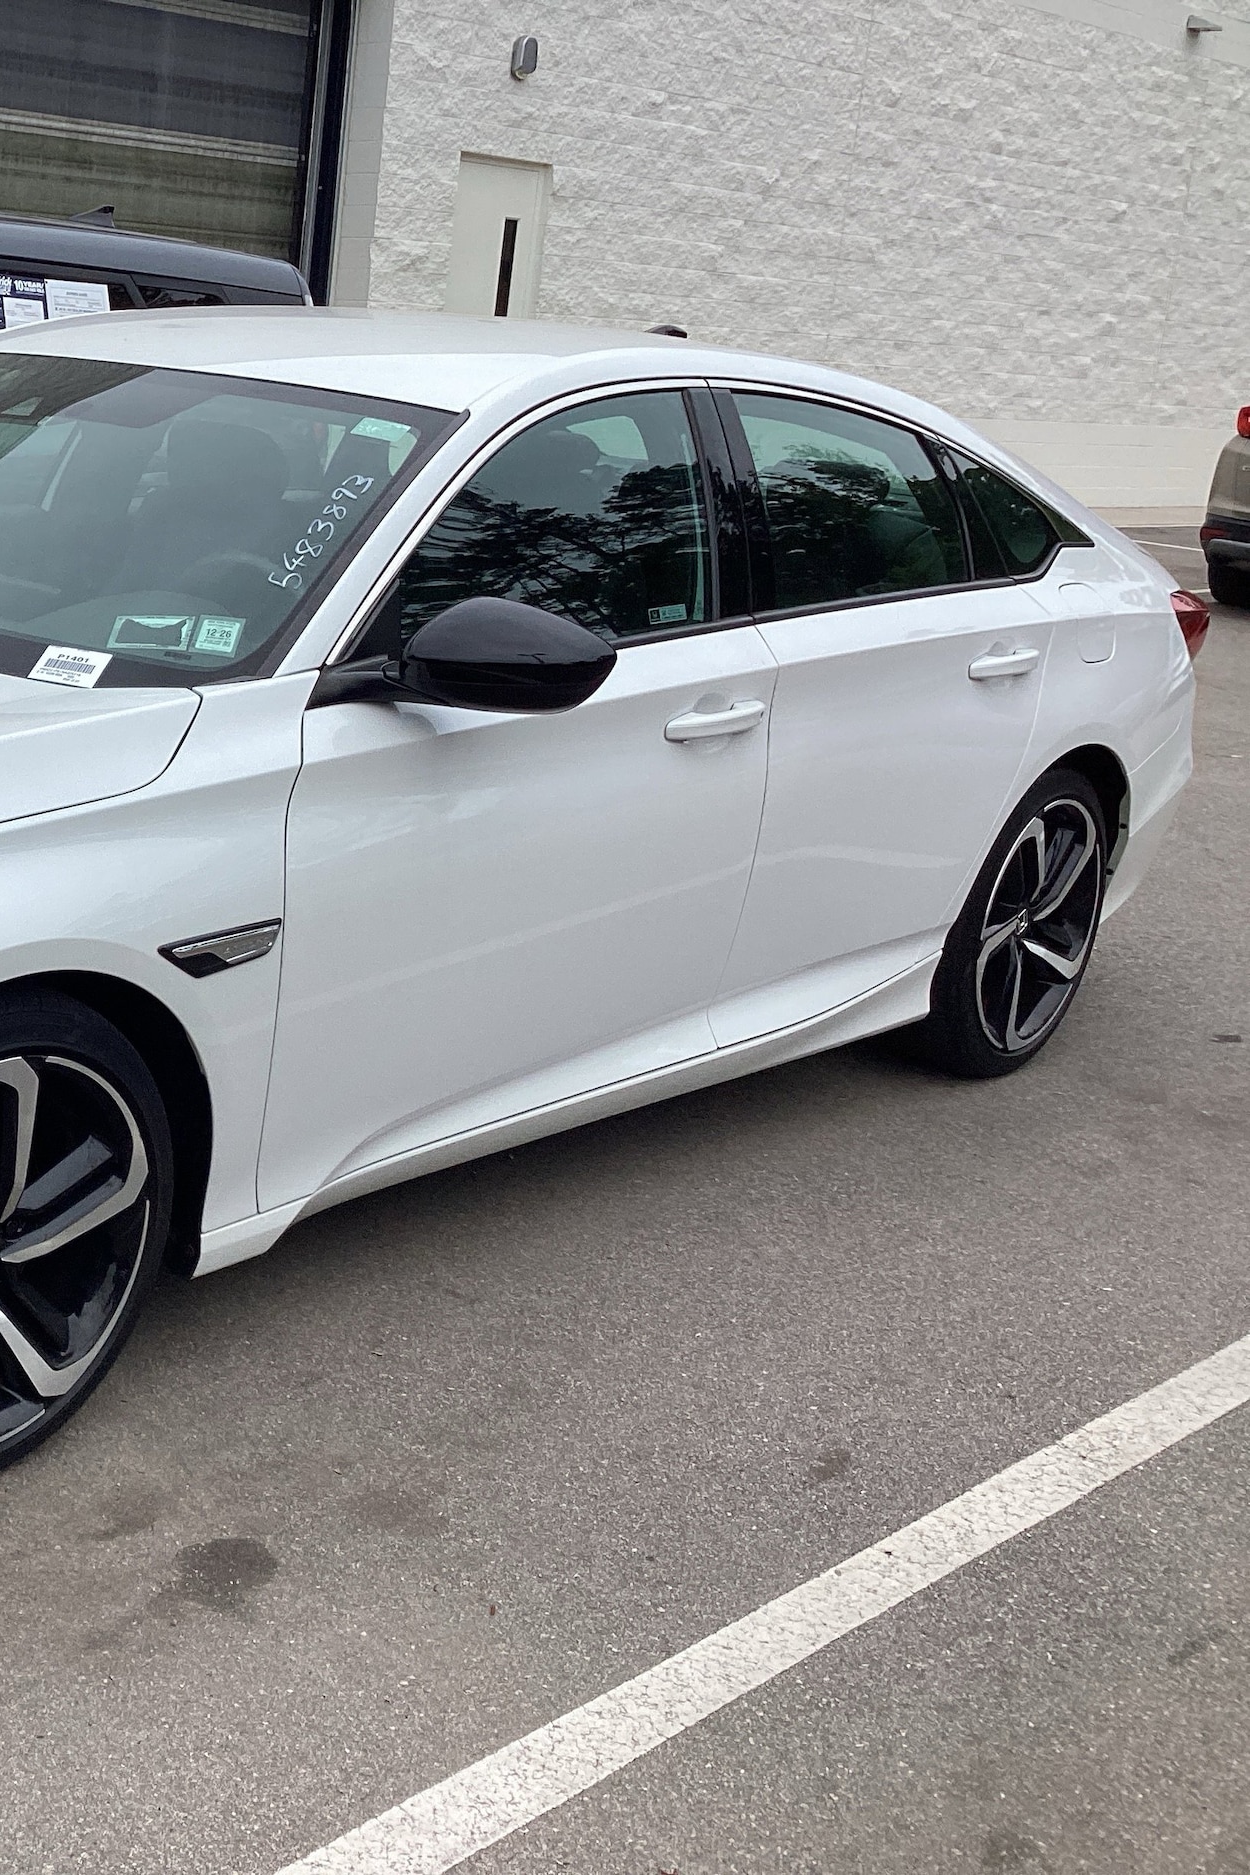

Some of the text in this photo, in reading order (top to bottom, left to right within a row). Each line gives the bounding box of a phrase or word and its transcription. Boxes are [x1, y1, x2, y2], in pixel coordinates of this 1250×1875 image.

[14, 280, 24, 291] 10
[268, 474, 374, 589] 5483893
[57, 654, 89, 663] P1401
